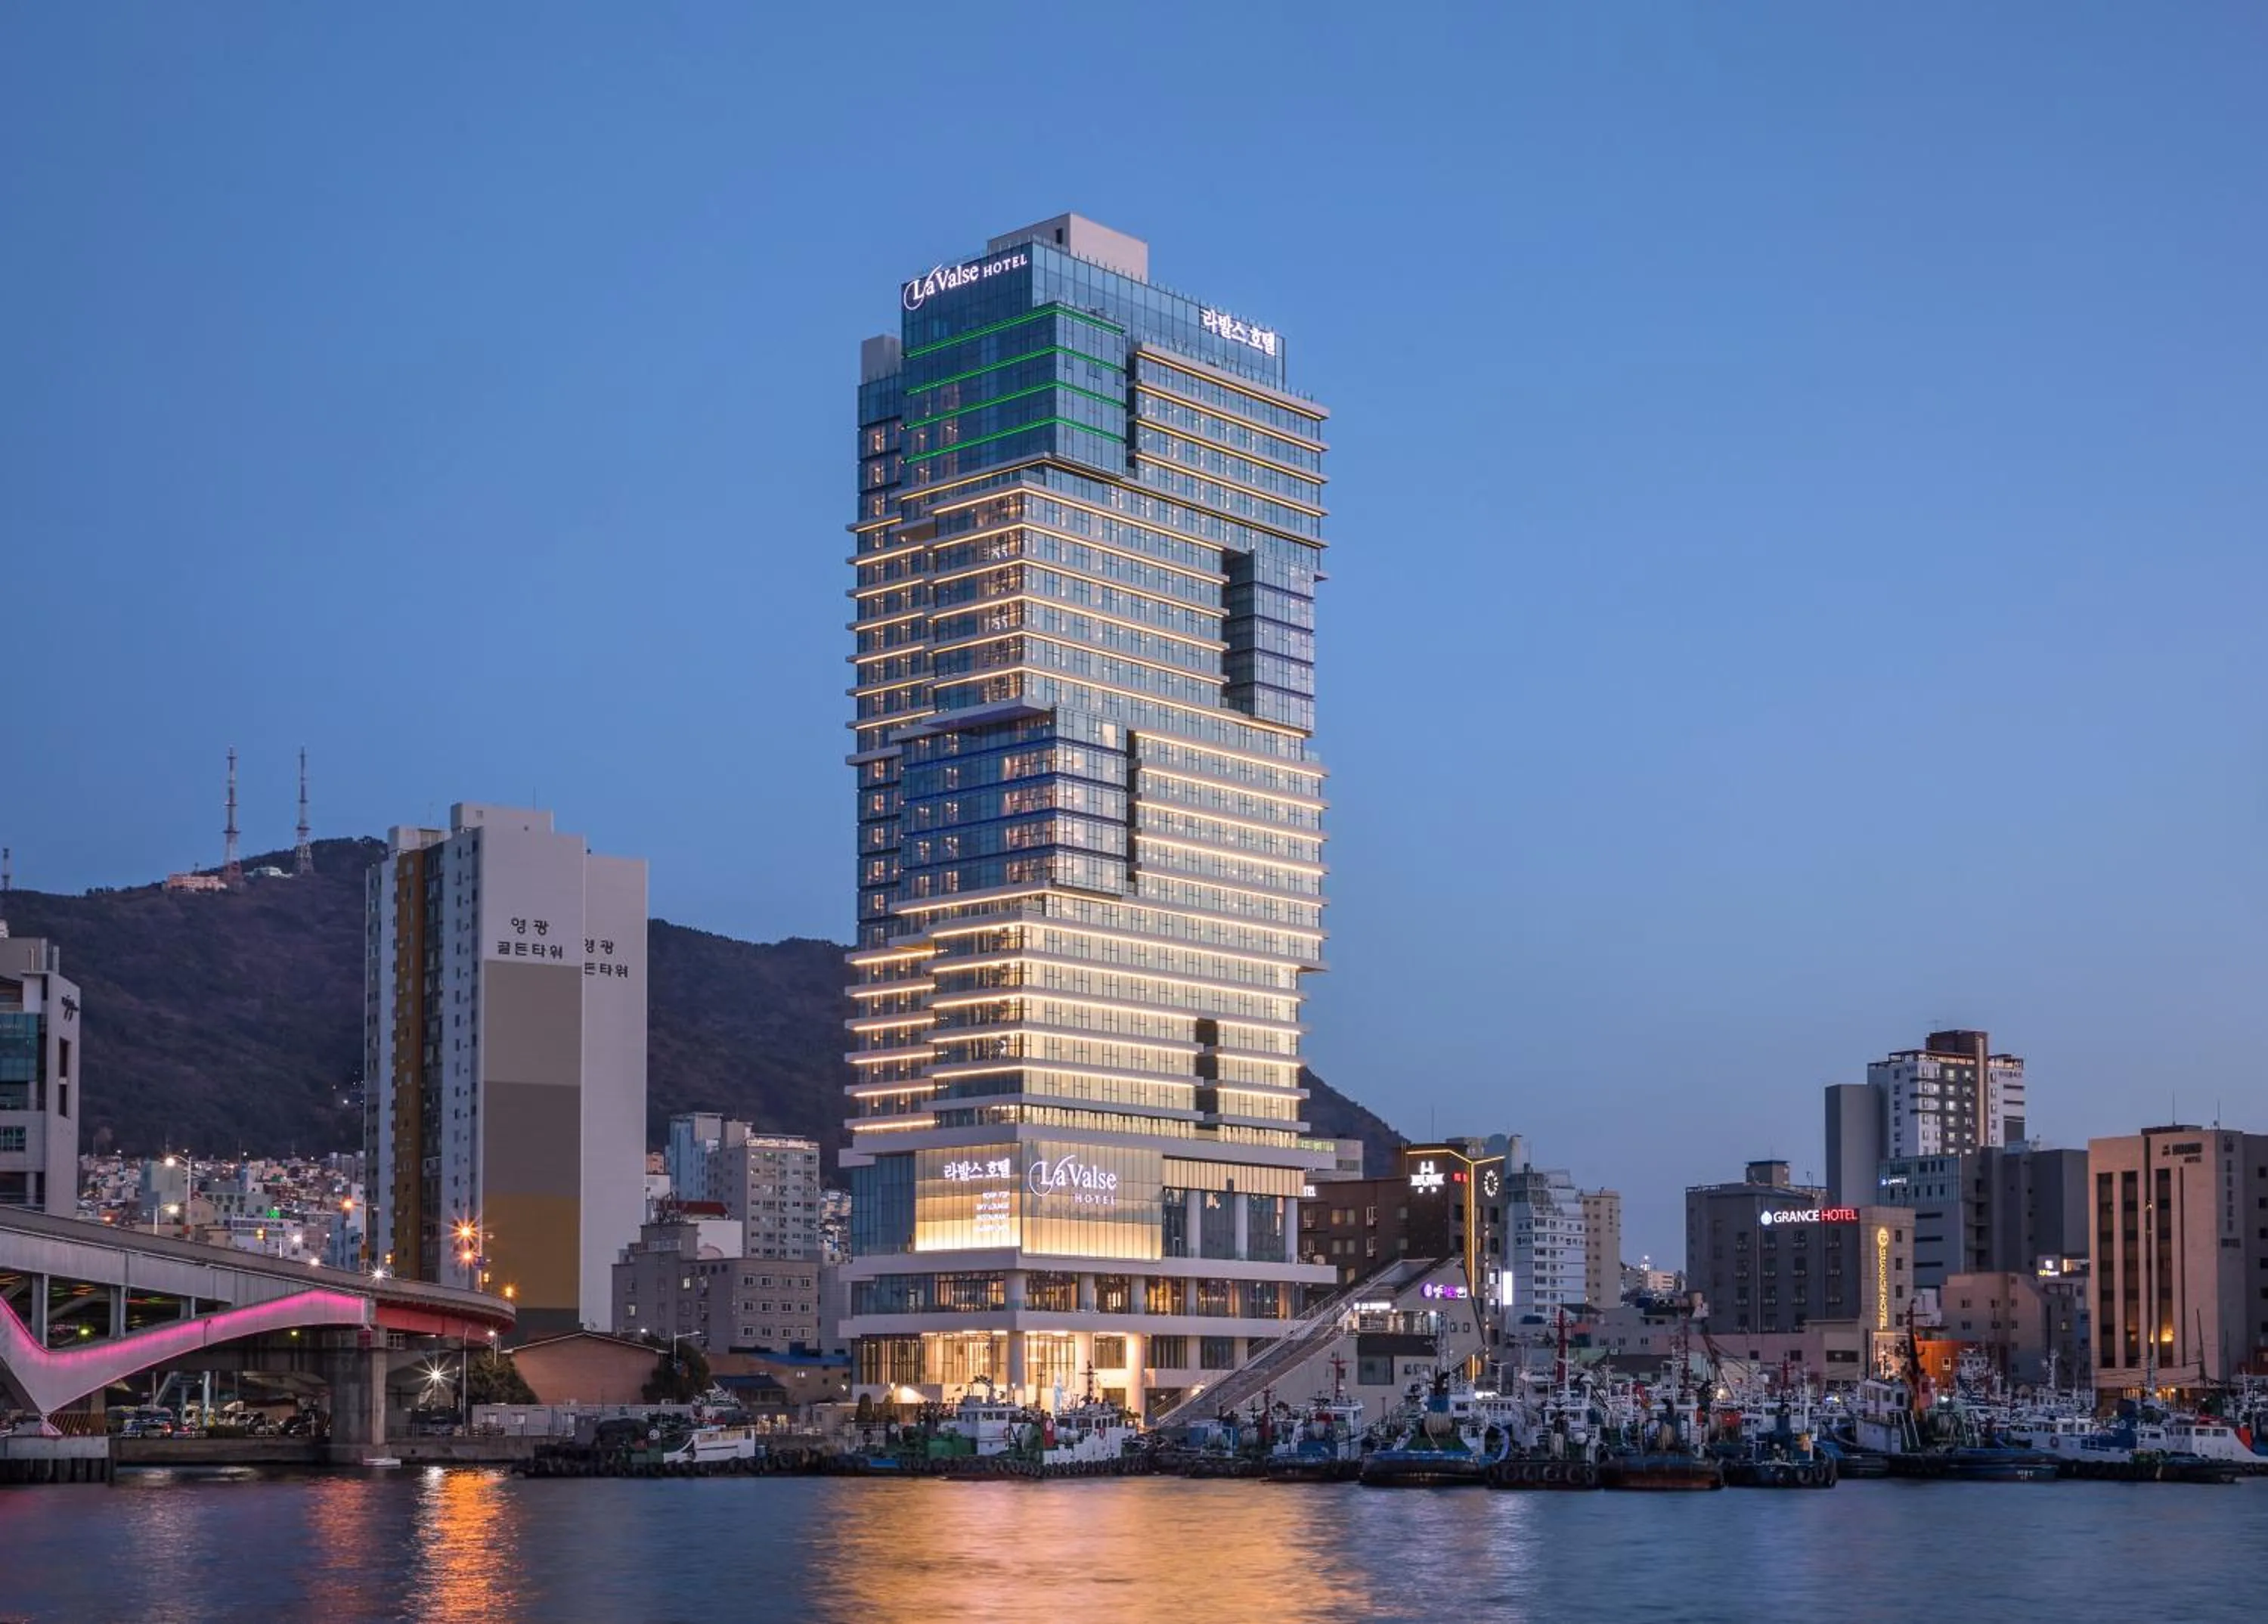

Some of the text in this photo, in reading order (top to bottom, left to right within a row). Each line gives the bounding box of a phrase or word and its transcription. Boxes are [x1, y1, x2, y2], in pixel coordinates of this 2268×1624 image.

[936, 265, 979, 291] Valse
[983, 253, 1027, 277] HOTEL
[1201, 308, 1275, 355] 라발스 호텔
[497, 941, 563, 959] 골든타워
[943, 1158, 1011, 1182] 라발스 호텔
[1067, 1164, 1117, 1190] Valse
[1074, 1194, 1114, 1205] HOTEL
[1773, 1209, 1858, 1223] GRANCE HOTEL
